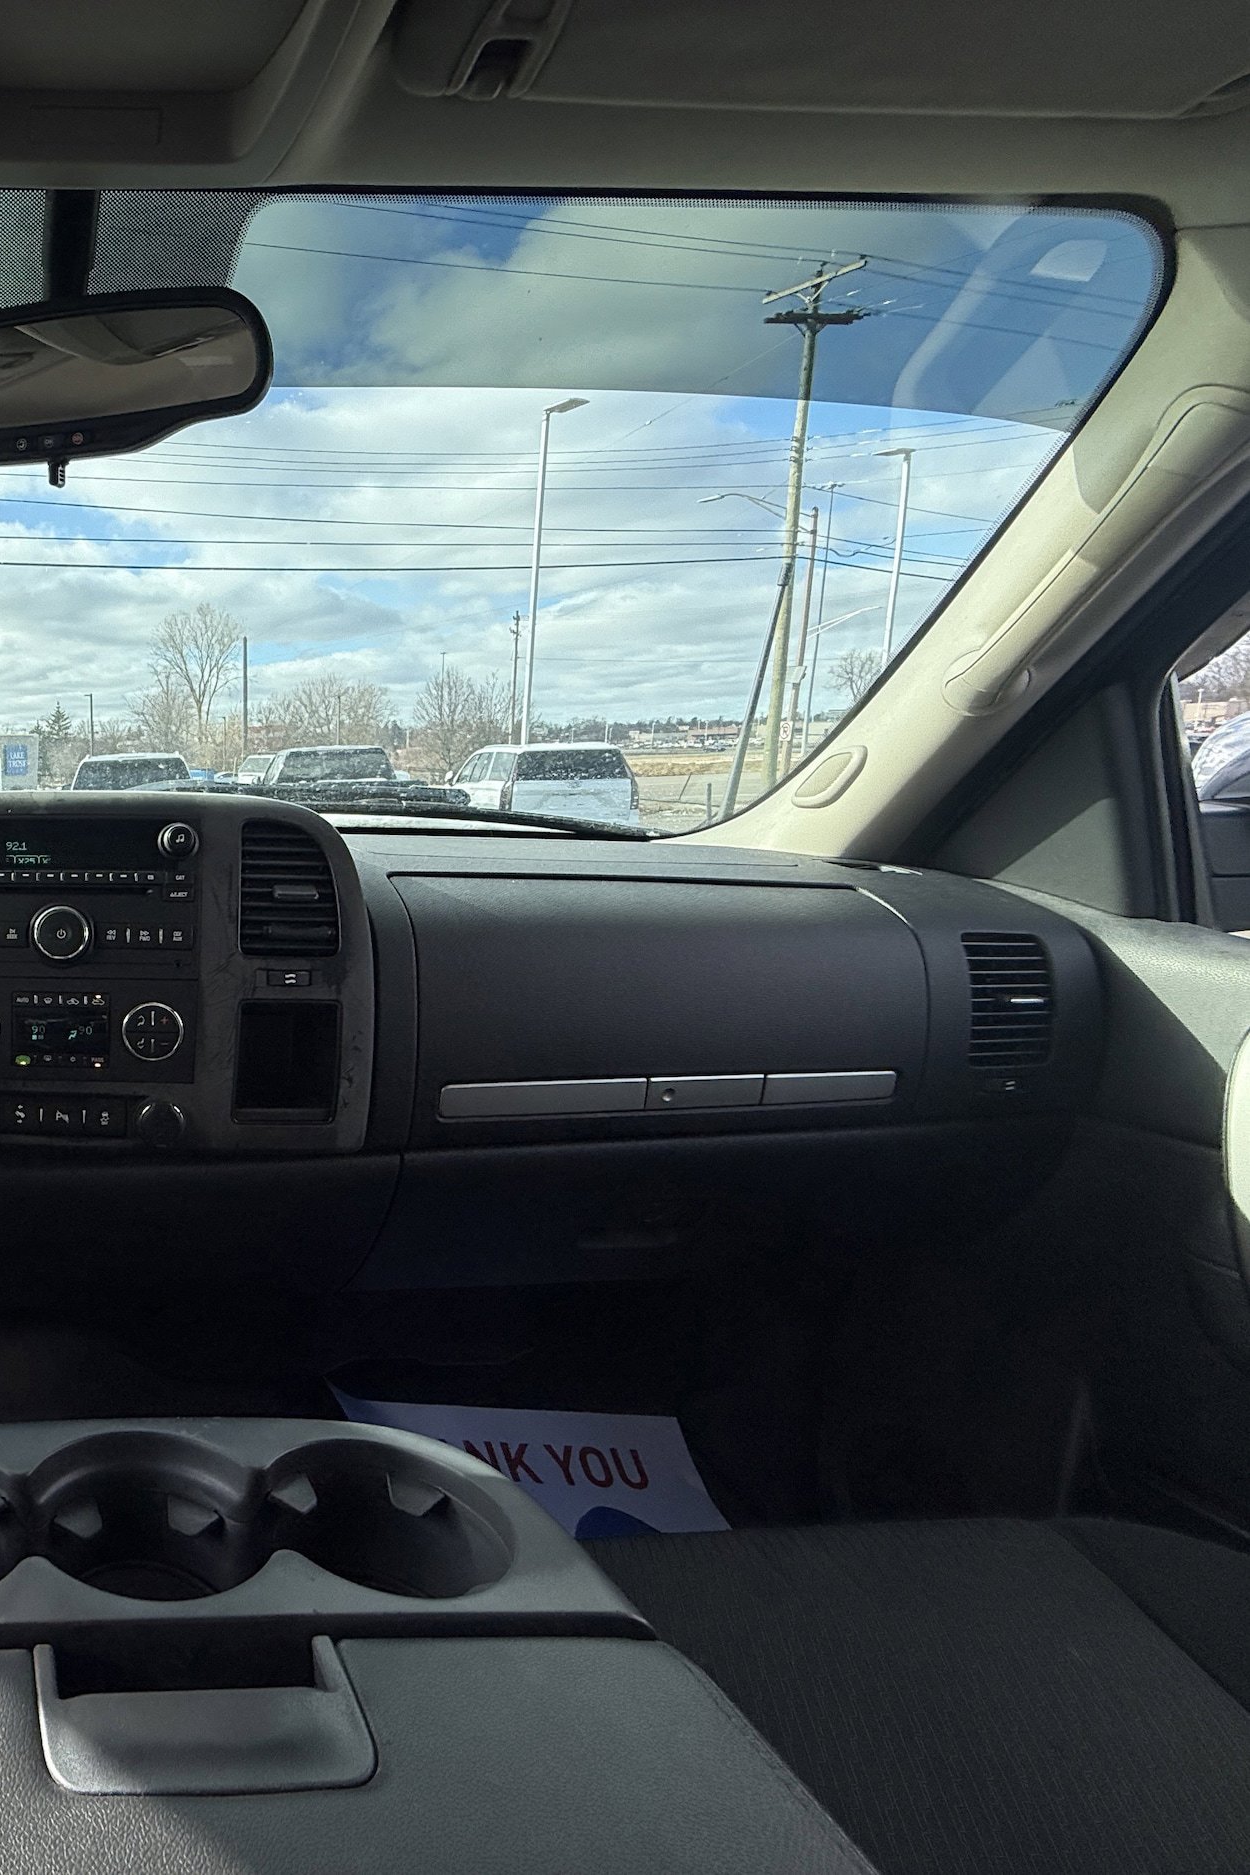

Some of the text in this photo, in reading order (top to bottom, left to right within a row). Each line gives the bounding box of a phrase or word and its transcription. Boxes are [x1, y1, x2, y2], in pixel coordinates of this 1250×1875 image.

[5, 841, 27, 851] 92.1
[31, 1025, 46, 1034] 90
[544, 1443, 650, 1490] YOU
